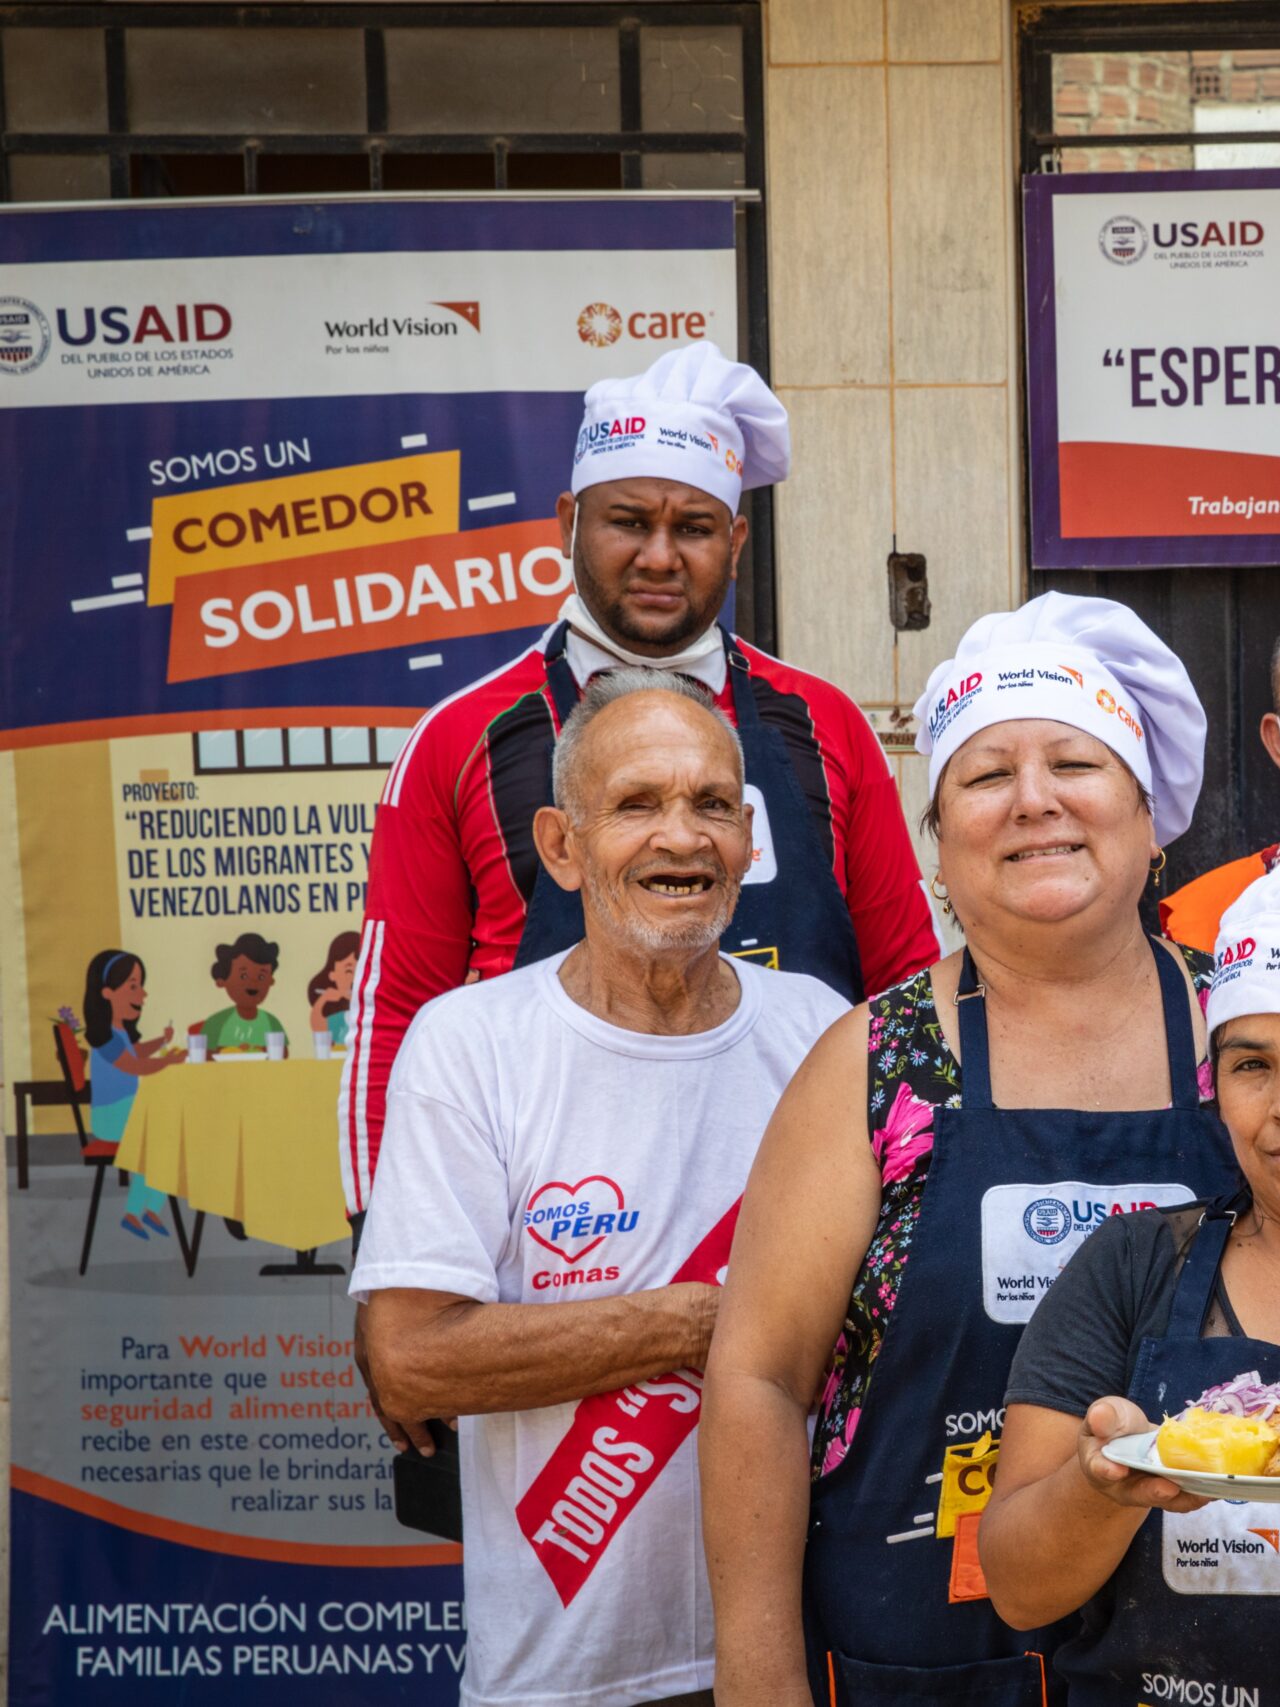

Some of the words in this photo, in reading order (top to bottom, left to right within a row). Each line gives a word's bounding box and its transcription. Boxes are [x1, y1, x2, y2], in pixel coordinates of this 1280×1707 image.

[1153, 221, 1264, 248] USAID
[1170, 251, 1199, 259] PUEBLO
[1229, 250, 1264, 258] ESTADOS
[56, 303, 232, 346] USAID
[324, 317, 388, 338] World
[392, 317, 458, 336] Vision
[627, 310, 707, 340] care
[61, 354, 83, 364] DEL
[87, 352, 131, 363] PUEBLO
[135, 351, 151, 362] DE
[154, 350, 178, 362] LOS
[180, 348, 234, 361] ESTADOS
[325, 344, 342, 354] Por
[346, 344, 359, 354] los
[87, 367, 135, 378] UNIDOS
[137, 366, 154, 377] DE
[158, 363, 210, 376] AMÉRICA
[588, 416, 646, 442] USAID
[659, 427, 688, 441] World
[689, 433, 712, 451] Vision
[149, 445, 256, 485] SOMOS
[264, 438, 311, 469] UN
[172, 481, 433, 554] COMEDOR
[200, 546, 572, 648] SOLIDARIO
[998, 668, 1034, 681] World
[1037, 669, 1073, 686] Vision
[1117, 705, 1143, 742] care
[122, 781, 200, 802] PROYECTO:
[125, 805, 287, 840] “REDUCIENDO
[293, 804, 322, 836] LA
[127, 849, 159, 879] DE
[167, 847, 206, 878] LOS
[214, 843, 354, 877] MIGRANTES
[129, 883, 301, 917] VENEZOLANOS
[308, 882, 338, 912] EN
[523, 1201, 591, 1226] SOMOS
[550, 1210, 640, 1241] PERU
[532, 1266, 620, 1290] Comas
[997, 1275, 1034, 1289] World
[997, 1293, 1008, 1301] Por
[121, 1336, 170, 1360] Para
[179, 1334, 266, 1359] World
[81, 1369, 212, 1397] importante
[224, 1371, 267, 1396] que
[279, 1364, 354, 1388] usted
[81, 1397, 212, 1428] seguridad
[81, 1428, 150, 1451] recibe
[161, 1434, 190, 1450] en
[201, 1432, 248, 1450] este
[258, 1426, 371, 1452] comedor,
[81, 1459, 202, 1482] necesarias
[208, 1464, 251, 1488] que
[260, 1457, 280, 1481] le
[231, 1488, 319, 1512] realizar
[328, 1493, 366, 1511] sus
[532, 1426, 655, 1564] TODOS
[1176, 1538, 1219, 1553] World
[1222, 1539, 1265, 1553] Vision
[1176, 1558, 1188, 1567] Por
[1190, 1558, 1199, 1567] los
[42, 1596, 306, 1635] ALIMENTACIÓN
[76, 1646, 223, 1677] FAMILIAS
[232, 1643, 414, 1676] PERUANAS
[417, 1643, 441, 1674] Y
[1141, 1672, 1216, 1707] SOMOS
[1221, 1684, 1259, 1707] UN
